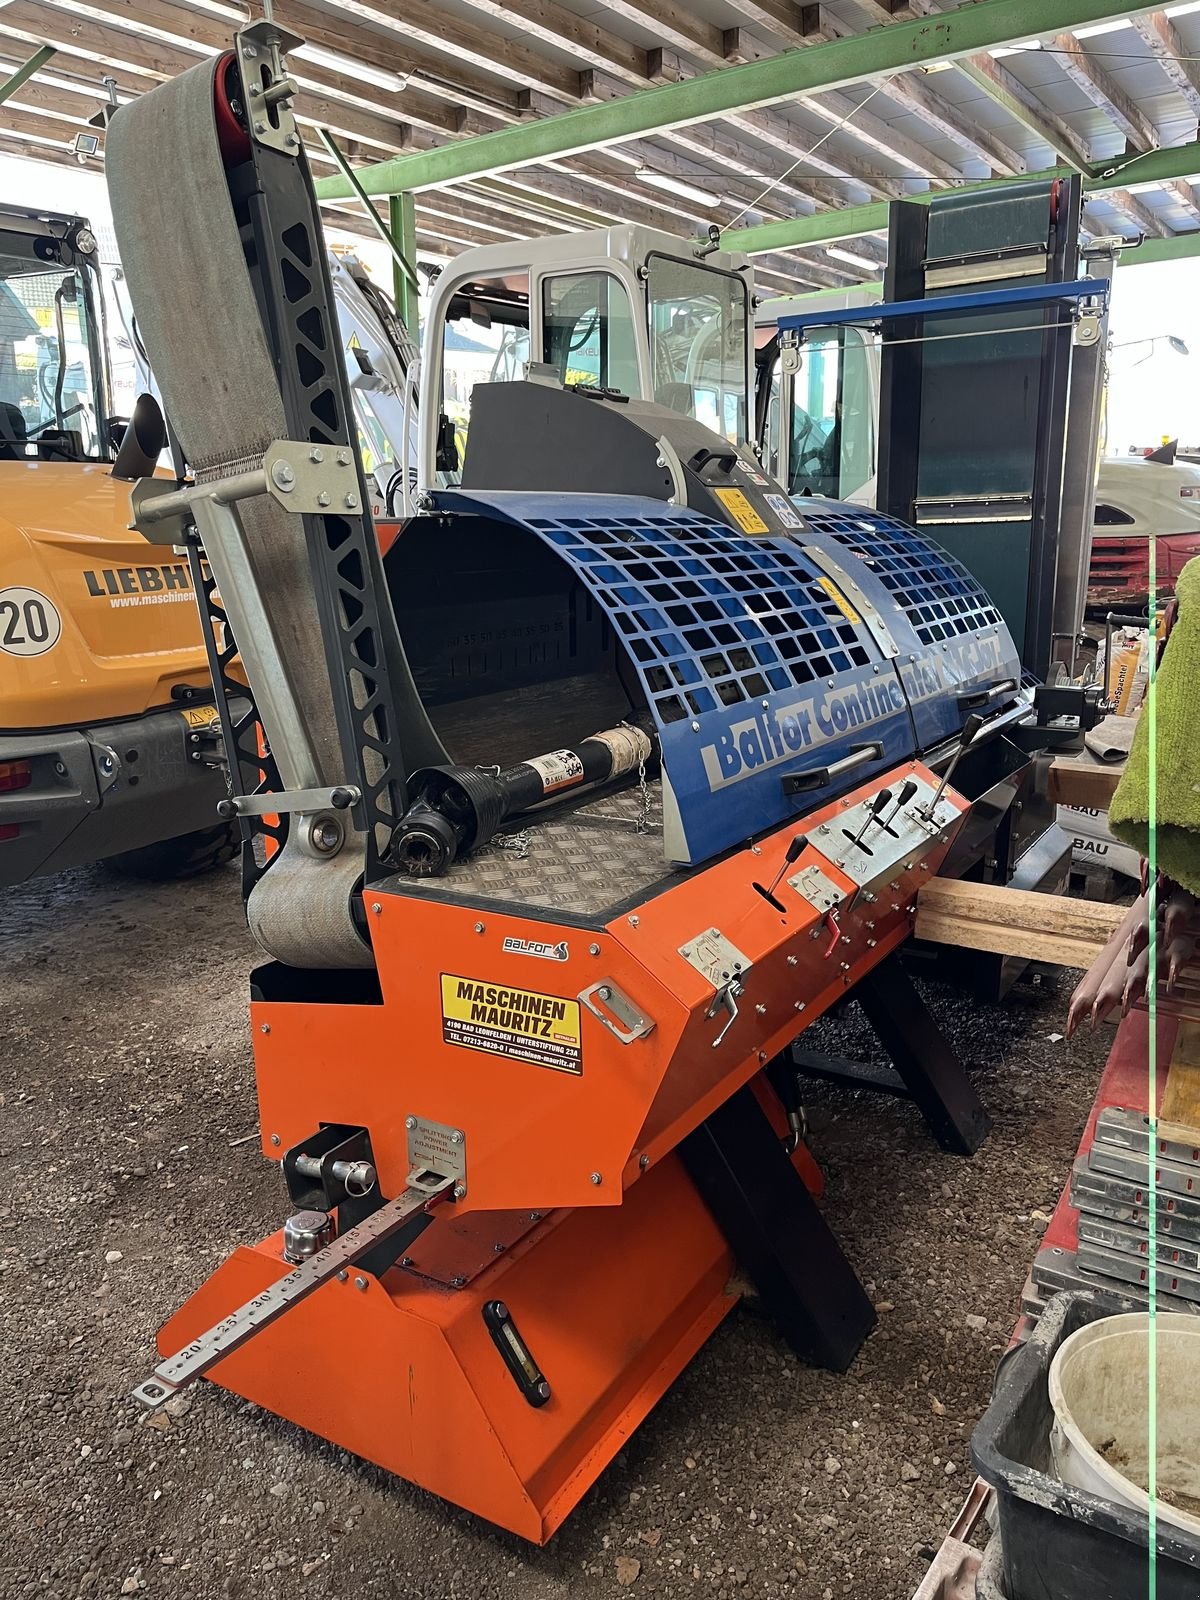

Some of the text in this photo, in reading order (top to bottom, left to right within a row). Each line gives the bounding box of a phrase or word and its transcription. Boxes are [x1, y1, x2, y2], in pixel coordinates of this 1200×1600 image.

[83, 563, 213, 597] LIEBH
[0, 599, 49, 645] 20
[714, 703, 812, 781] Balfor
[456, 981, 566, 1020] MASCHINEN
[470, 1003, 553, 1037] MAURITZ
[450, 1033, 462, 1041] TEL.
[462, 1023, 474, 1032] BAD
[475, 1026, 512, 1041] LEONFELDEN
[516, 1036, 565, 1054] UNTERSTIFTUNG
[565, 1048, 578, 1057] 23A
[345, 1231, 360, 1242] 45
[316, 1251, 333, 1263] 40
[284, 1272, 303, 1285] 35
[251, 1294, 271, 1308] 30
[217, 1318, 238, 1333] 25
[181, 1345, 202, 1360] 20
